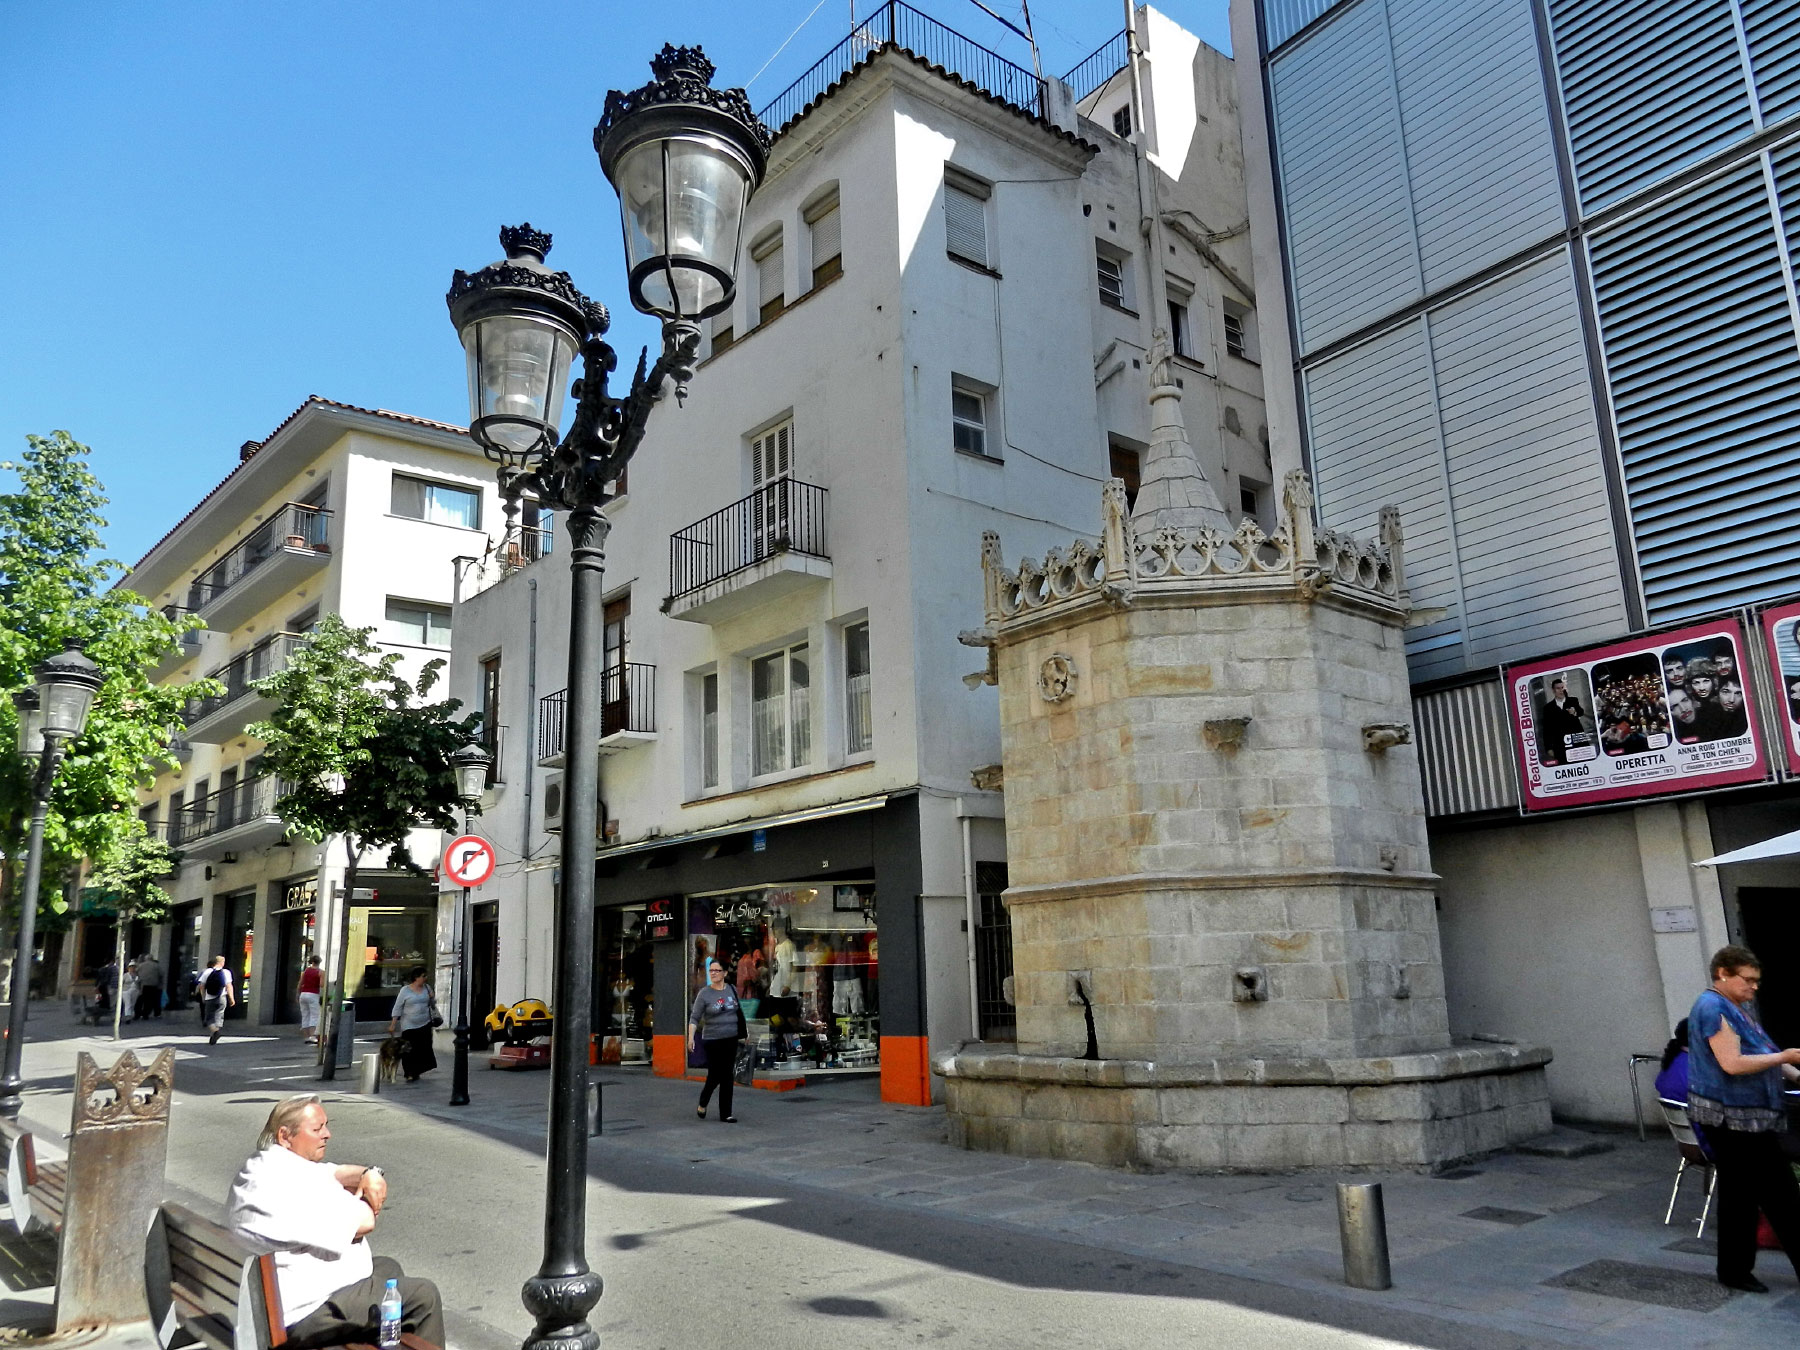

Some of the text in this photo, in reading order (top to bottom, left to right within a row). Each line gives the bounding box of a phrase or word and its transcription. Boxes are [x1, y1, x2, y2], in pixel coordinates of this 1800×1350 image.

[1519, 684, 1542, 790] Teatre de Blanes
[1678, 746, 1697, 755] ANNA
[1699, 743, 1715, 752] ROIG
[1722, 737, 1752, 748] L'OMBRE
[1702, 751, 1716, 759] TON
[1718, 747, 1741, 757] CHIEN
[1615, 754, 1666, 770] OPERETTA
[1555, 764, 1589, 779] CANIGÓ
[715, 902, 760, 922] Surf Shop
